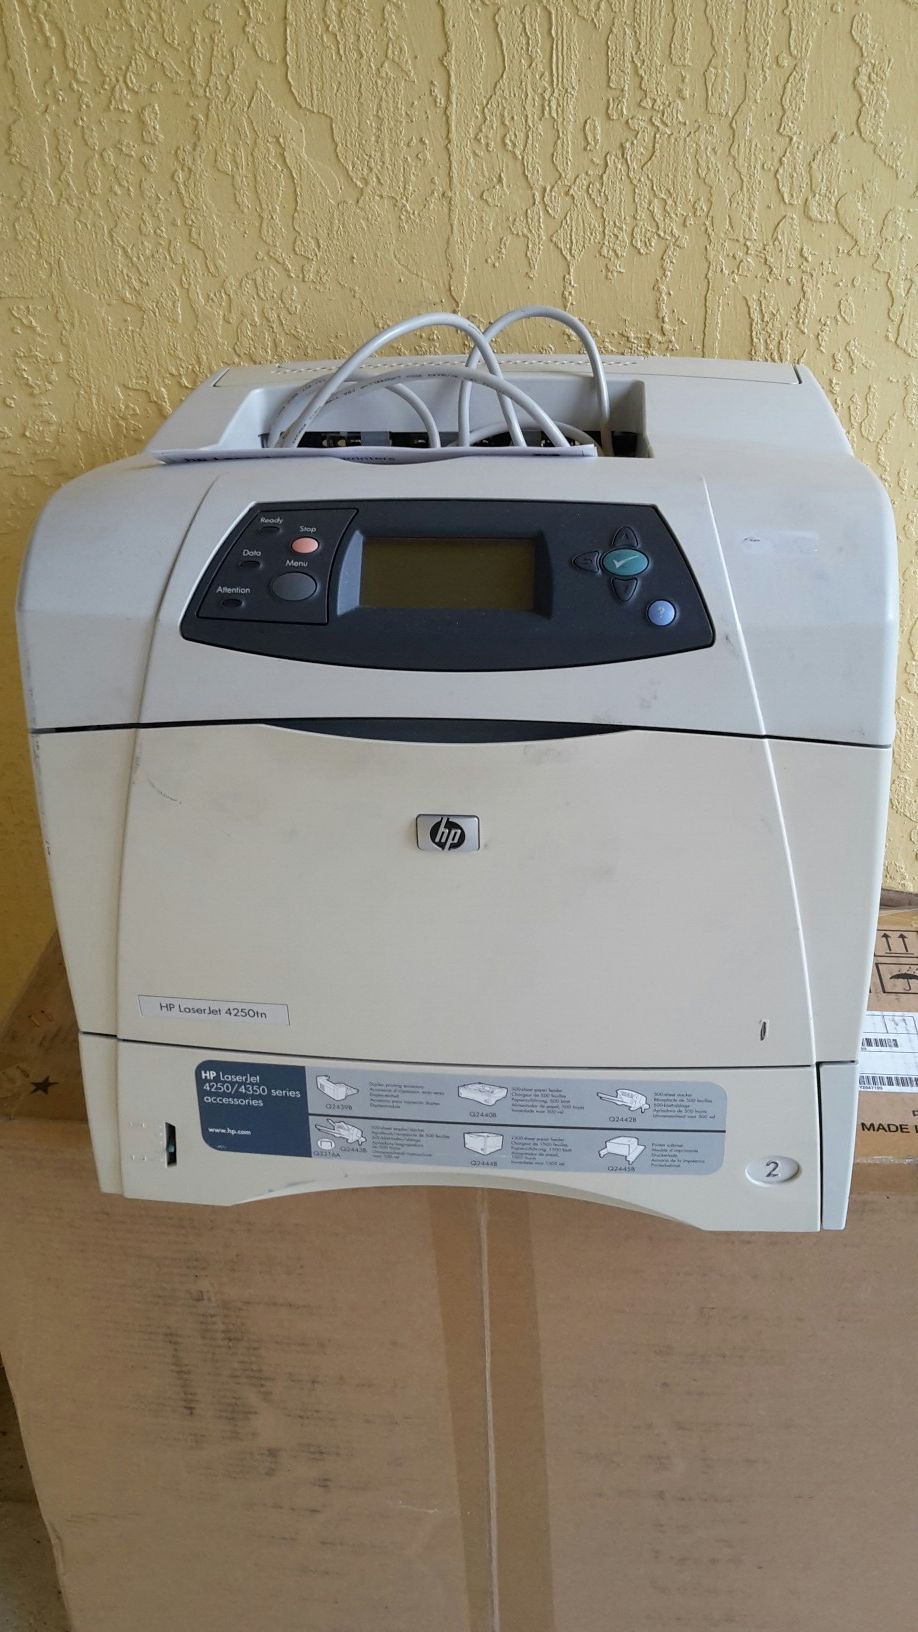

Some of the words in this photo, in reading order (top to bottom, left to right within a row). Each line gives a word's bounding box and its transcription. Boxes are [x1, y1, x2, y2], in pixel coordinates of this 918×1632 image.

[260, 517, 283, 525] Ready
[299, 525, 317, 533] Stop
[242, 549, 262, 557] Data
[285, 559, 308, 567] Menu
[216, 586, 251, 594] Attention
[434, 816, 462, 851] hp
[160, 1002, 175, 1011] HP
[178, 1003, 222, 1016] LaserJet
[225, 1007, 267, 1019] 4250tn
[201, 1070, 217, 1080] HP
[219, 1072, 260, 1083] LaserJet
[203, 1083, 268, 1095] 4250/4350
[271, 1088, 301, 1098] series
[203, 1096, 264, 1107] accessories
[208, 1127, 252, 1136] www.hp.com
[860, 1122, 911, 1134] MADE
[765, 1160, 779, 1178] 2
